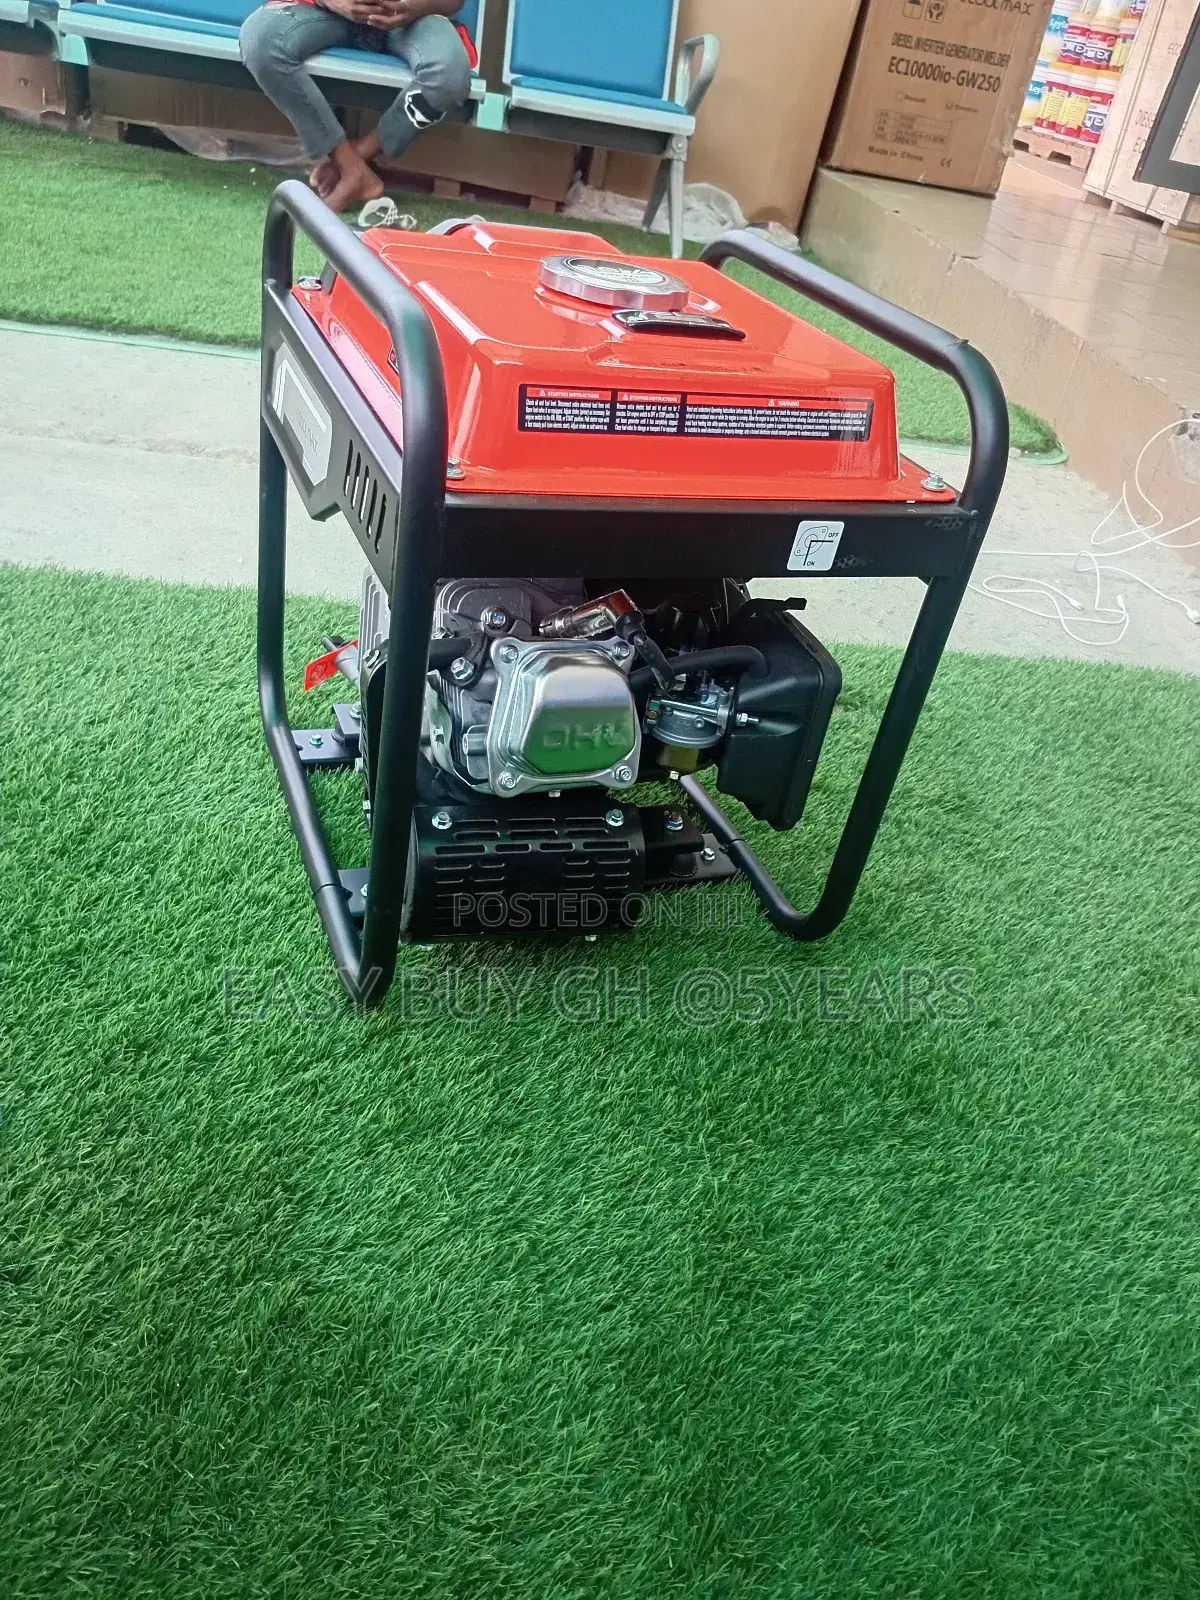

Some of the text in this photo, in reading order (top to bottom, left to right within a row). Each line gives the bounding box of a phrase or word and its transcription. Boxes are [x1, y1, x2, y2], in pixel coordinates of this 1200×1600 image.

[891, 33, 1011, 67] DIESEL INVERTER GENERATOR WELDER
[888, 56, 1001, 93] EC10000io-GW250
[868, 145, 923, 161] Made in China
